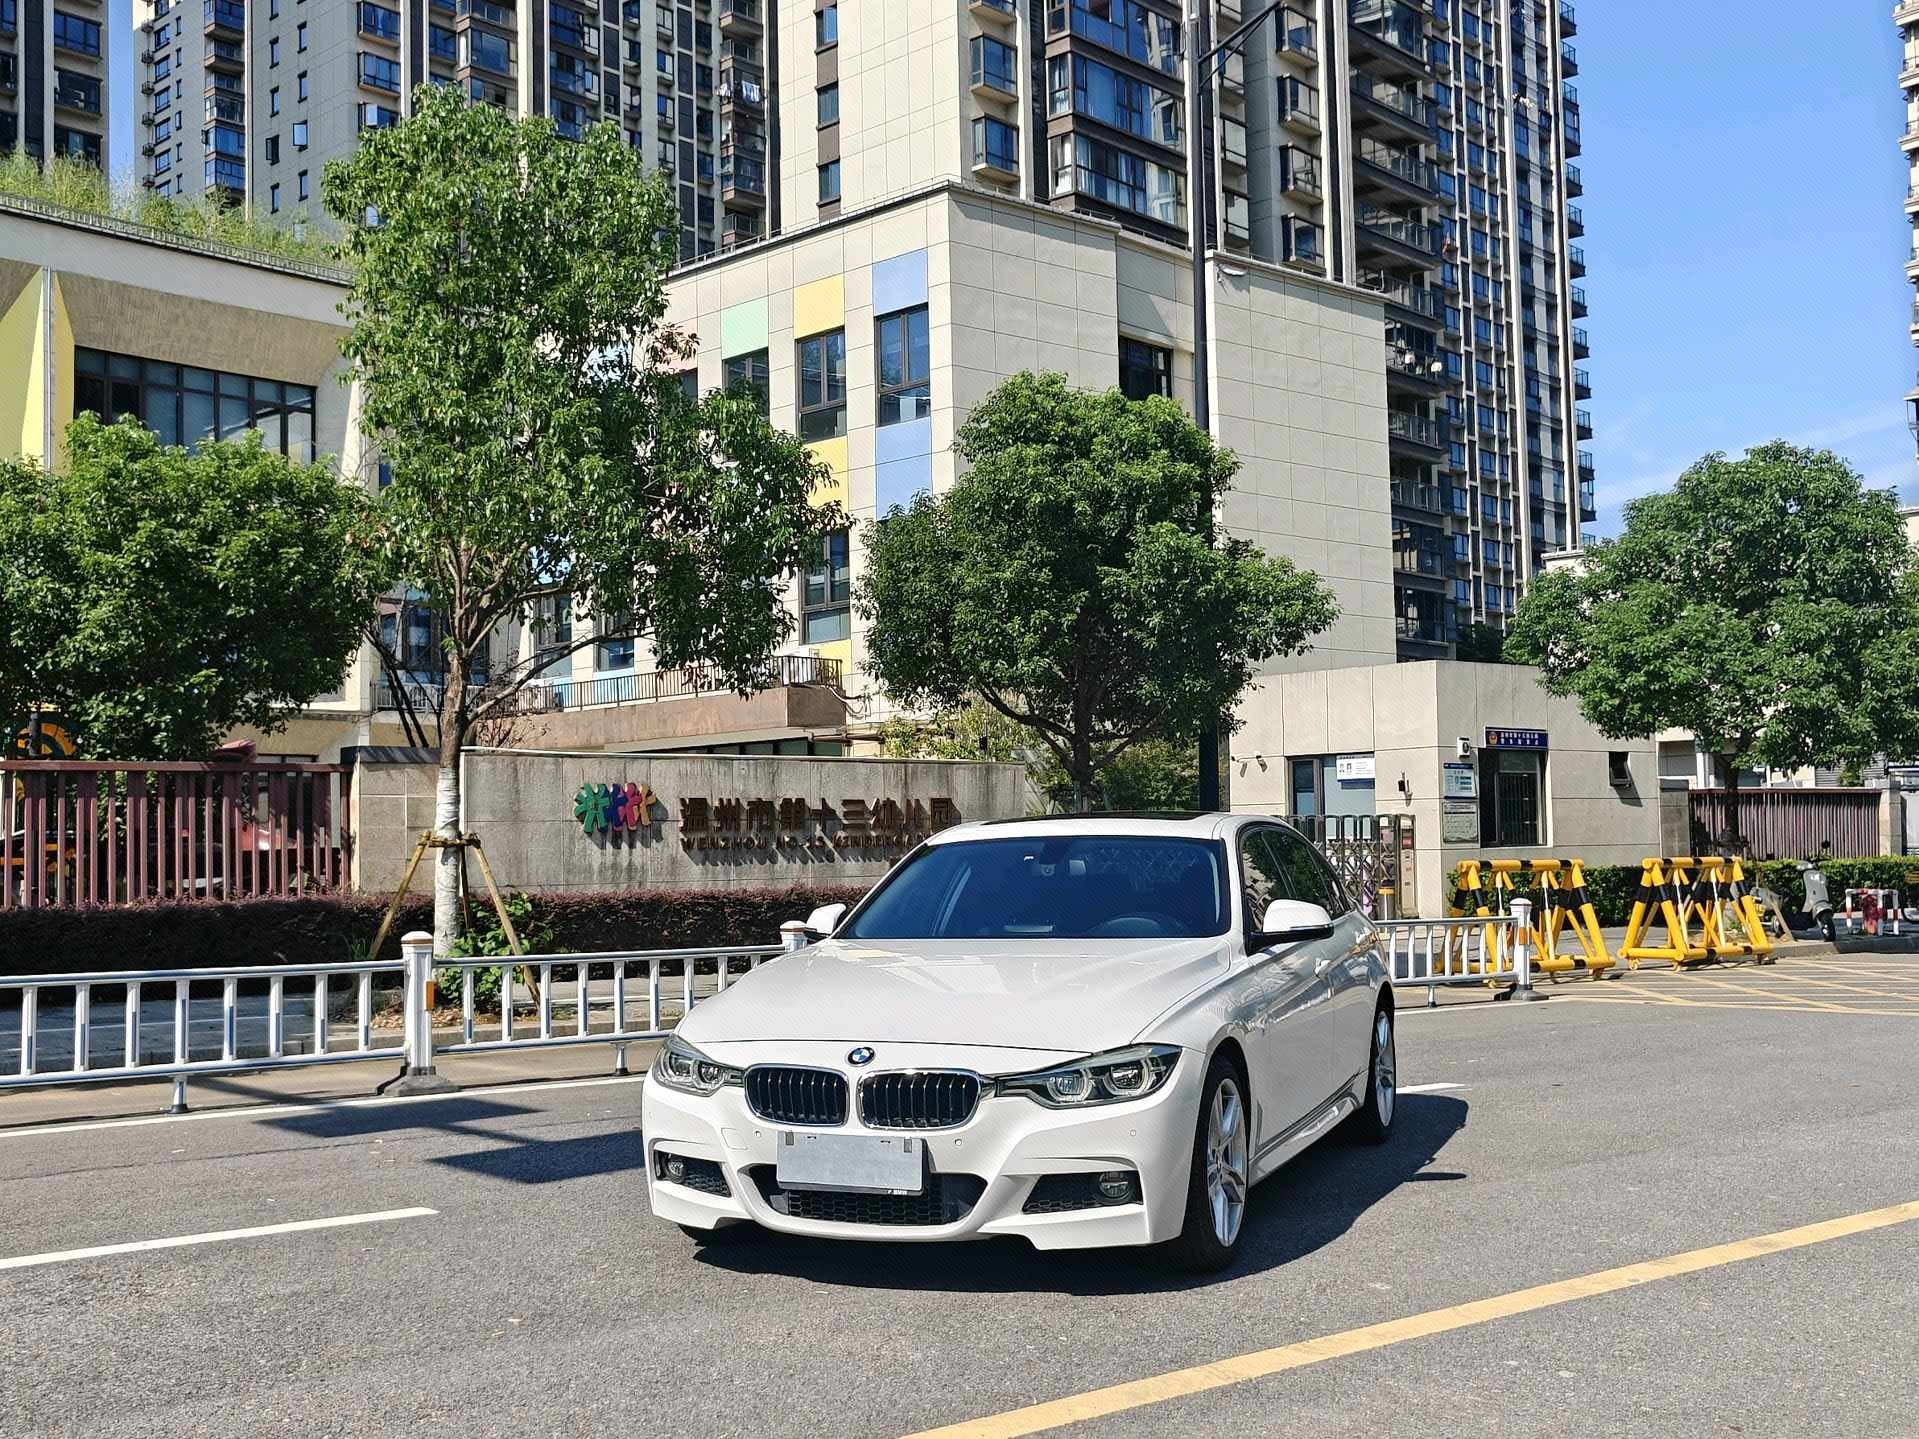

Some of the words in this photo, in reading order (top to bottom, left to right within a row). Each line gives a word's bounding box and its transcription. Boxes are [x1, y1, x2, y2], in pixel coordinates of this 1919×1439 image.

[679, 797, 952, 832] 温州市第十三幼儿园
[680, 836, 768, 849] WENZHOU
